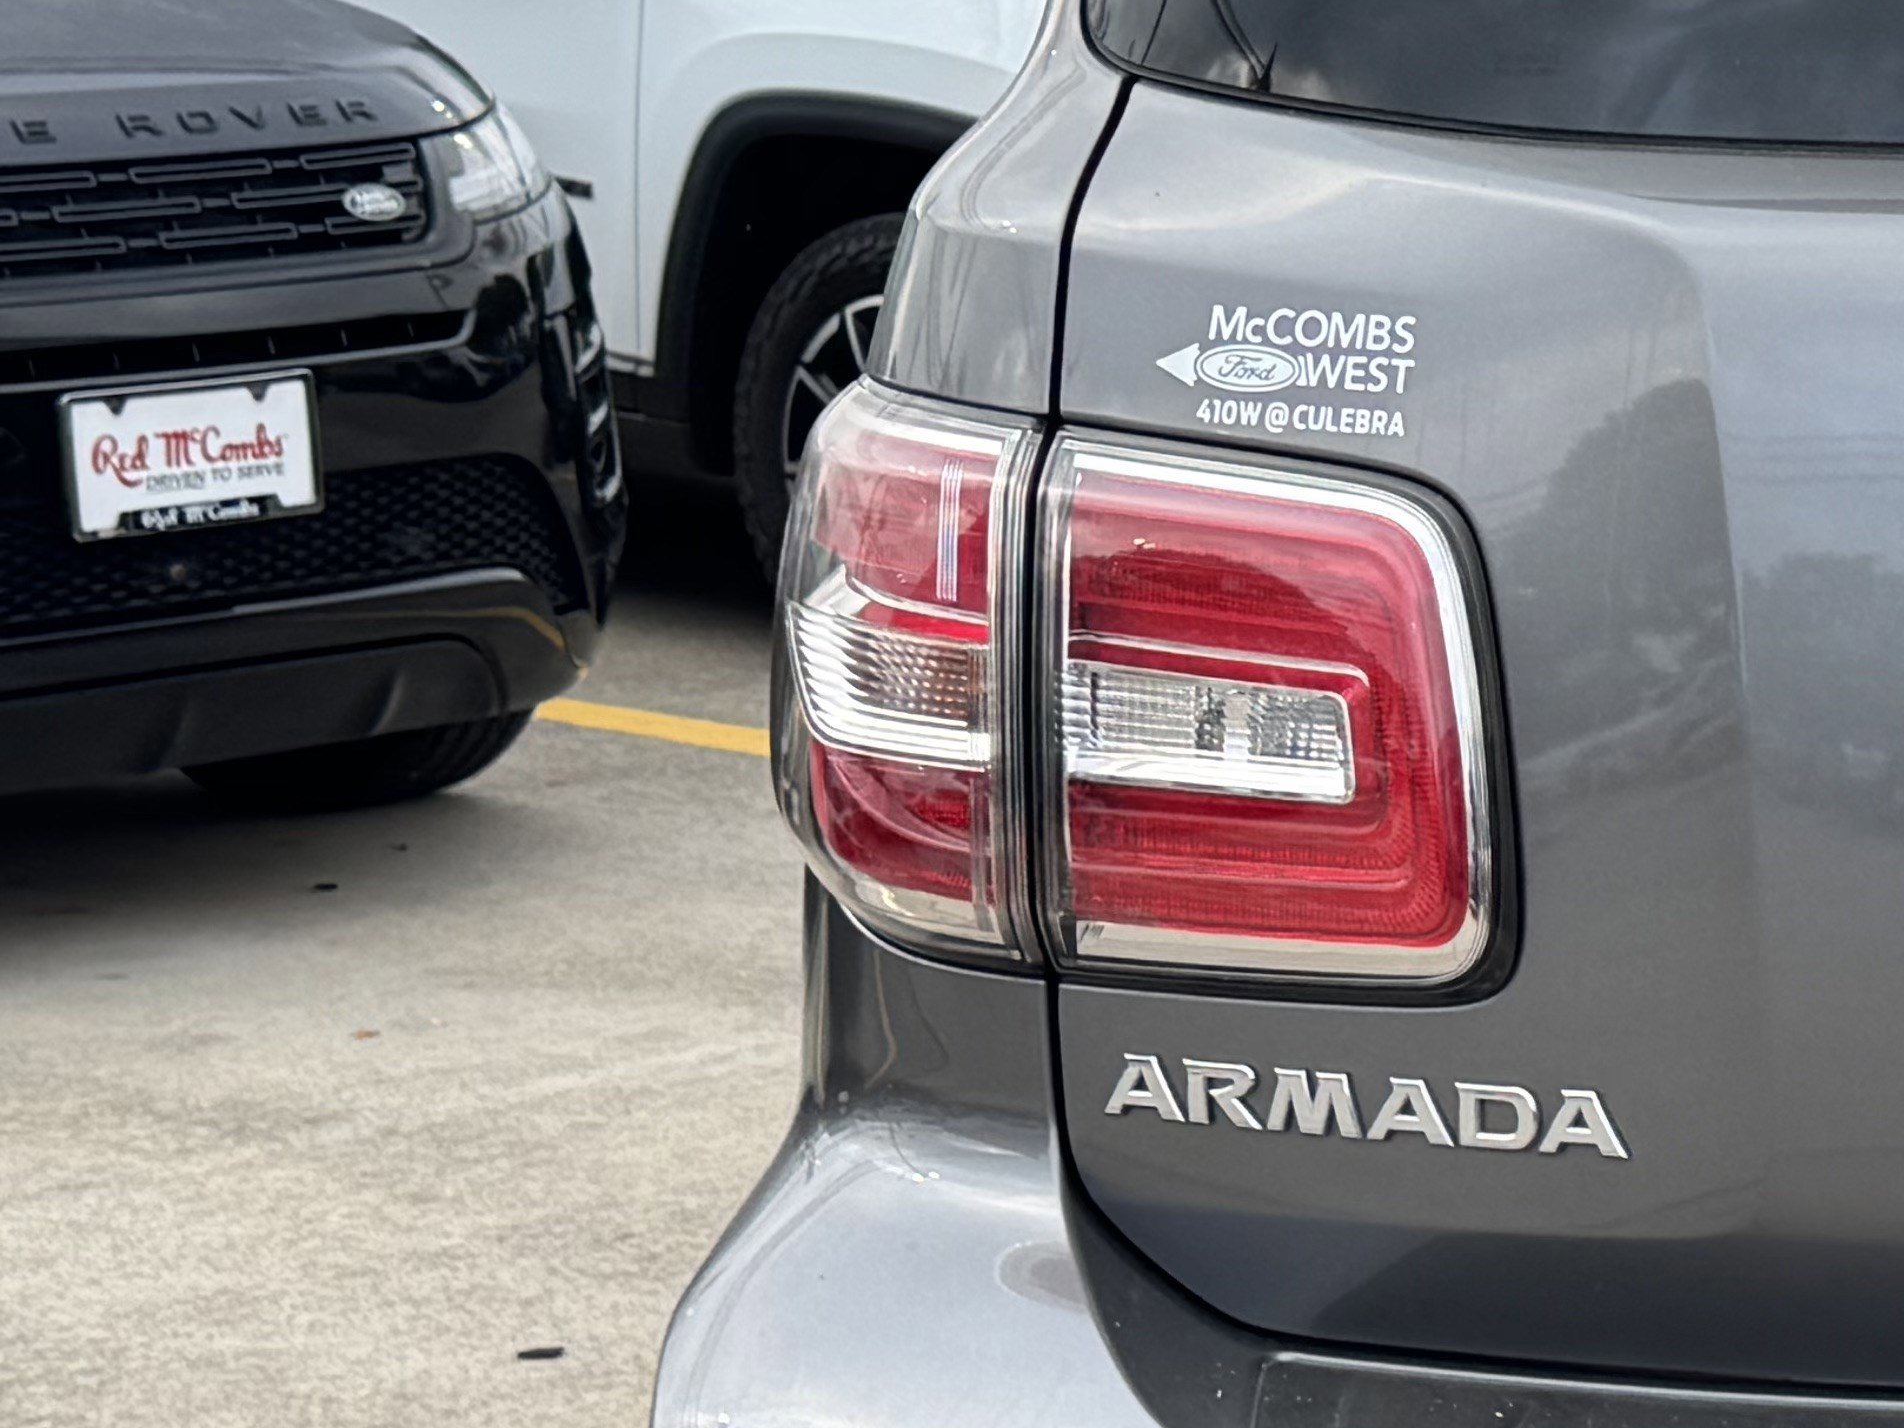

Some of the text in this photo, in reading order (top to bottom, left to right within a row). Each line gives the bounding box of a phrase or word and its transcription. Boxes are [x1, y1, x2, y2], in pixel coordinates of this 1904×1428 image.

[115, 99, 379, 140] ROVER
[1208, 304, 1417, 354] McCOMBS
[1218, 352, 1416, 395] Ford WEST
[91, 423, 284, 488] Red McCombs
[212, 464, 233, 482] TO
[1104, 1052, 1630, 1160] ARMADA
